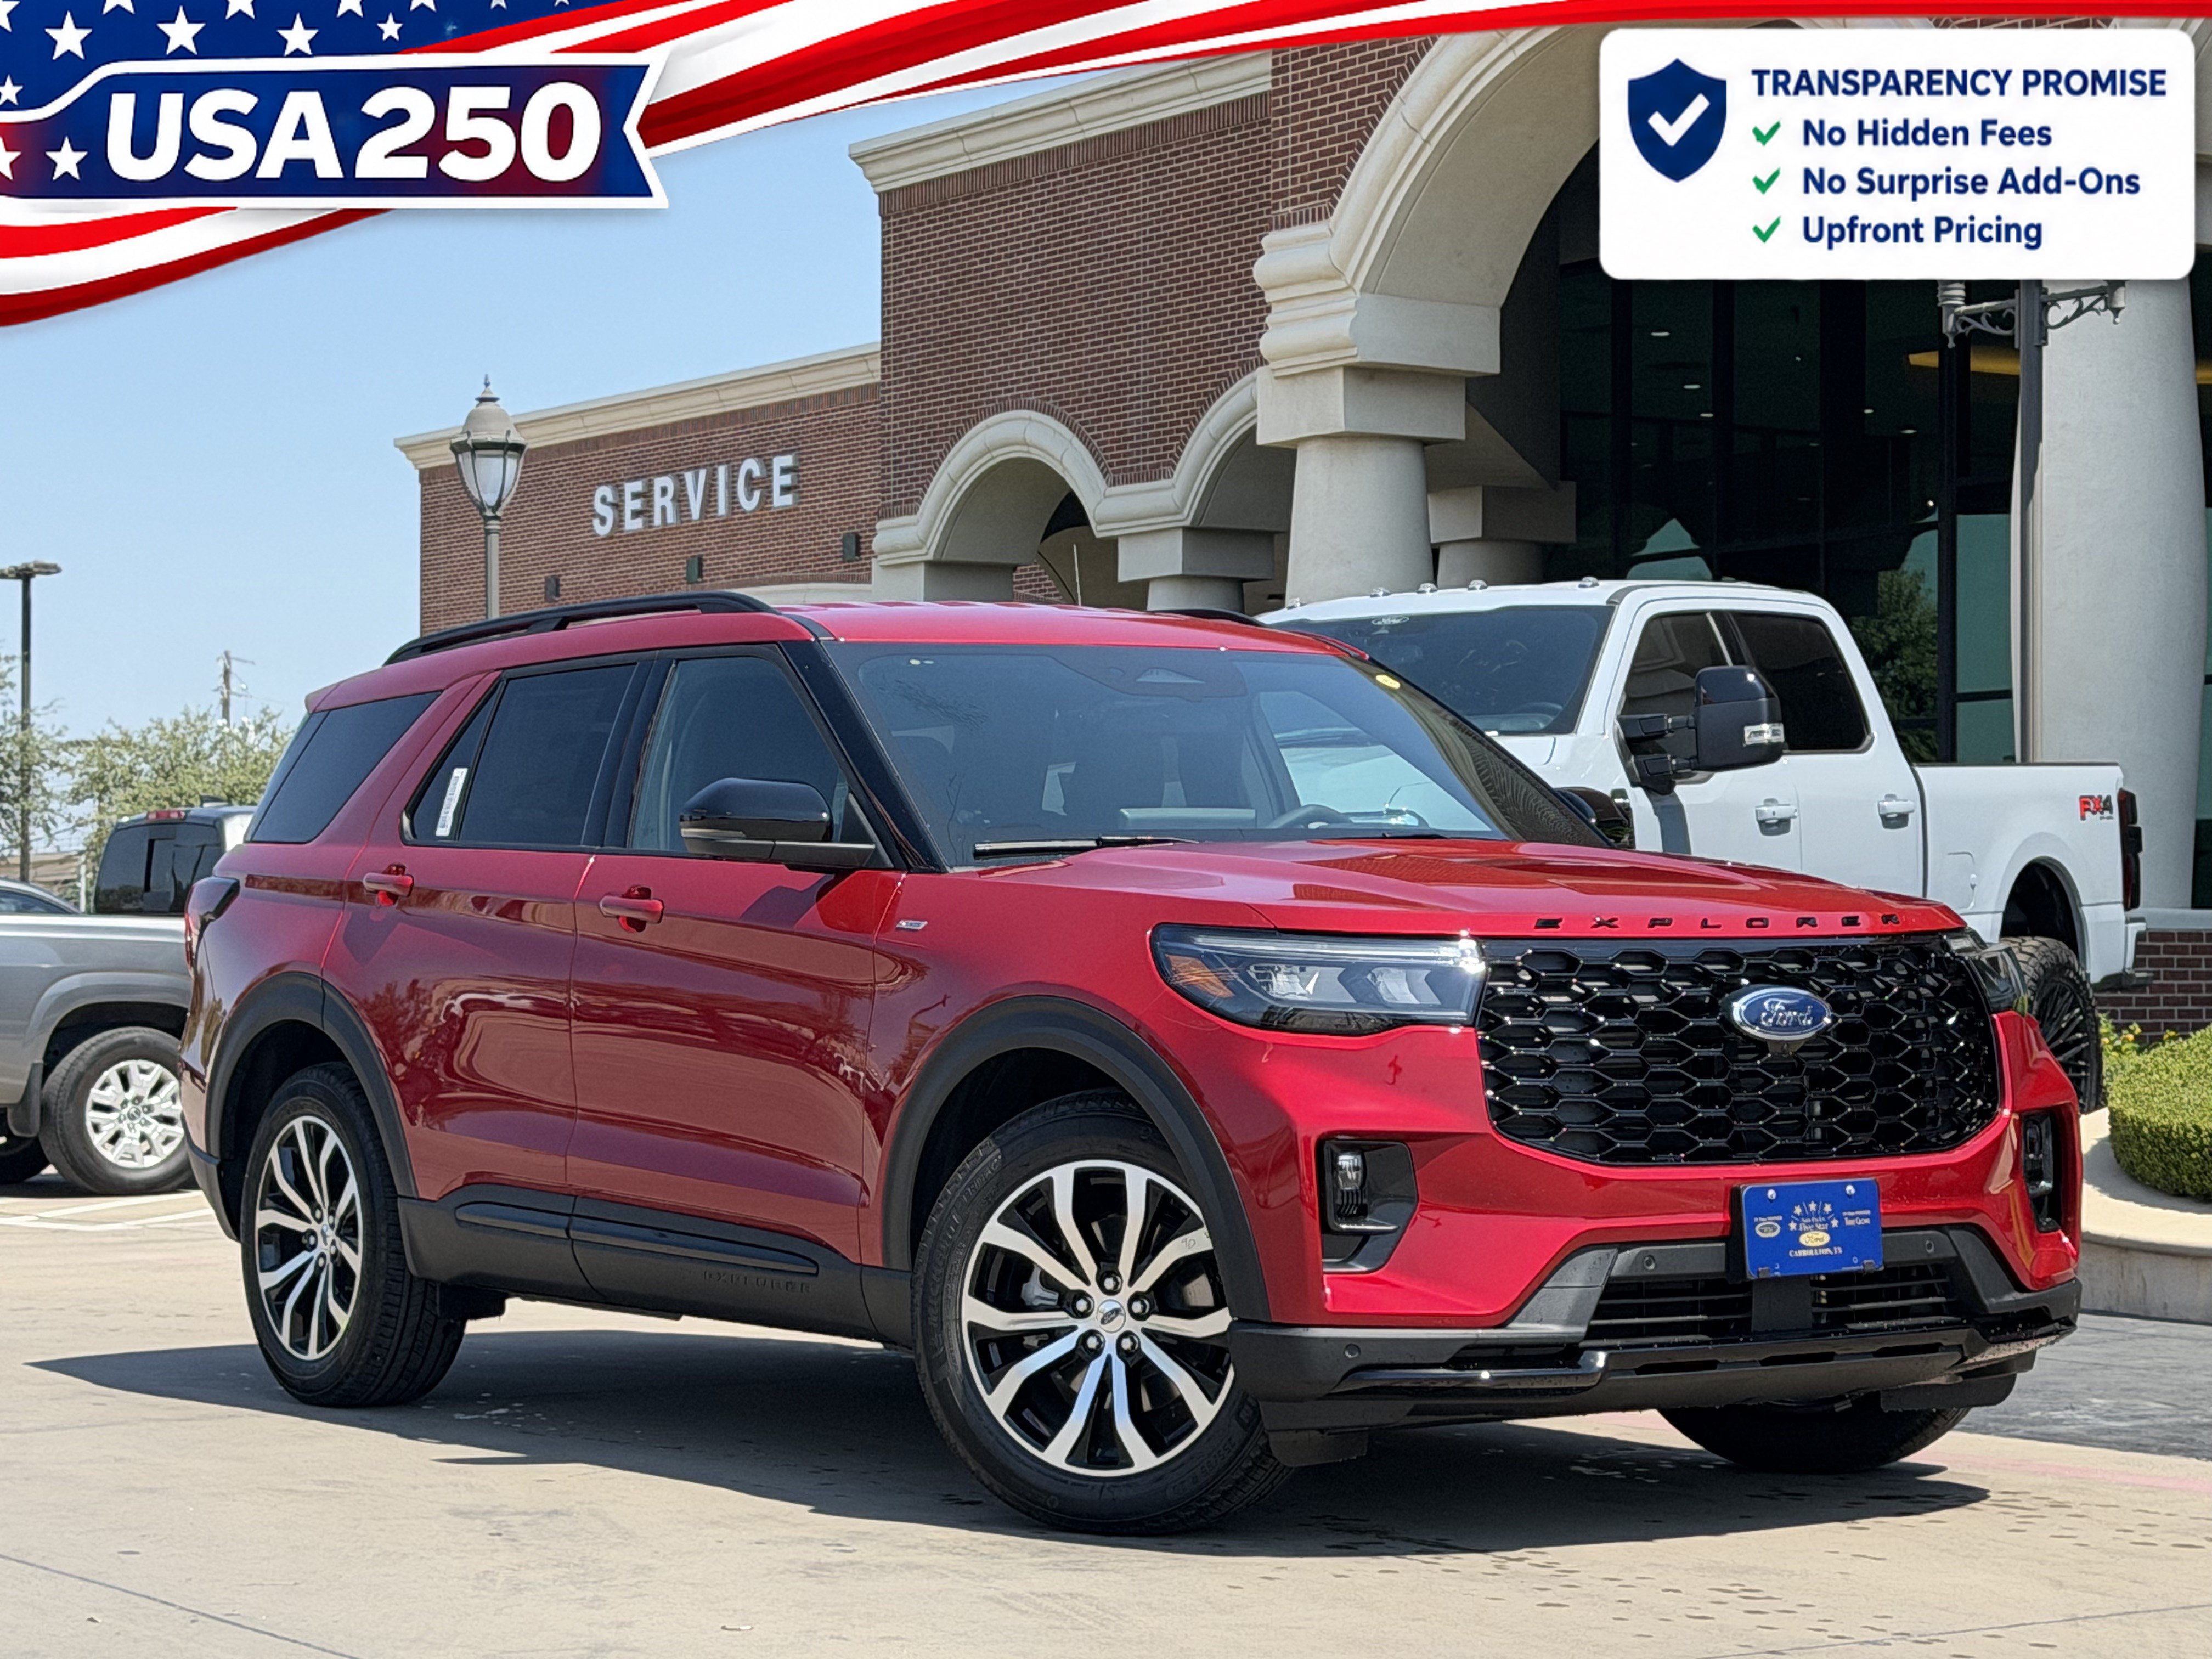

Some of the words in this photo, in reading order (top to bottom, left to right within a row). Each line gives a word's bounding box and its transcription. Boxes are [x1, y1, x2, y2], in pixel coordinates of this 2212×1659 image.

[592, 453, 797, 537] SERVICE
[2079, 794, 2113, 821] FX4
[1534, 914, 1900, 929] EXPLORER
[1761, 997, 1814, 1027] Ford
